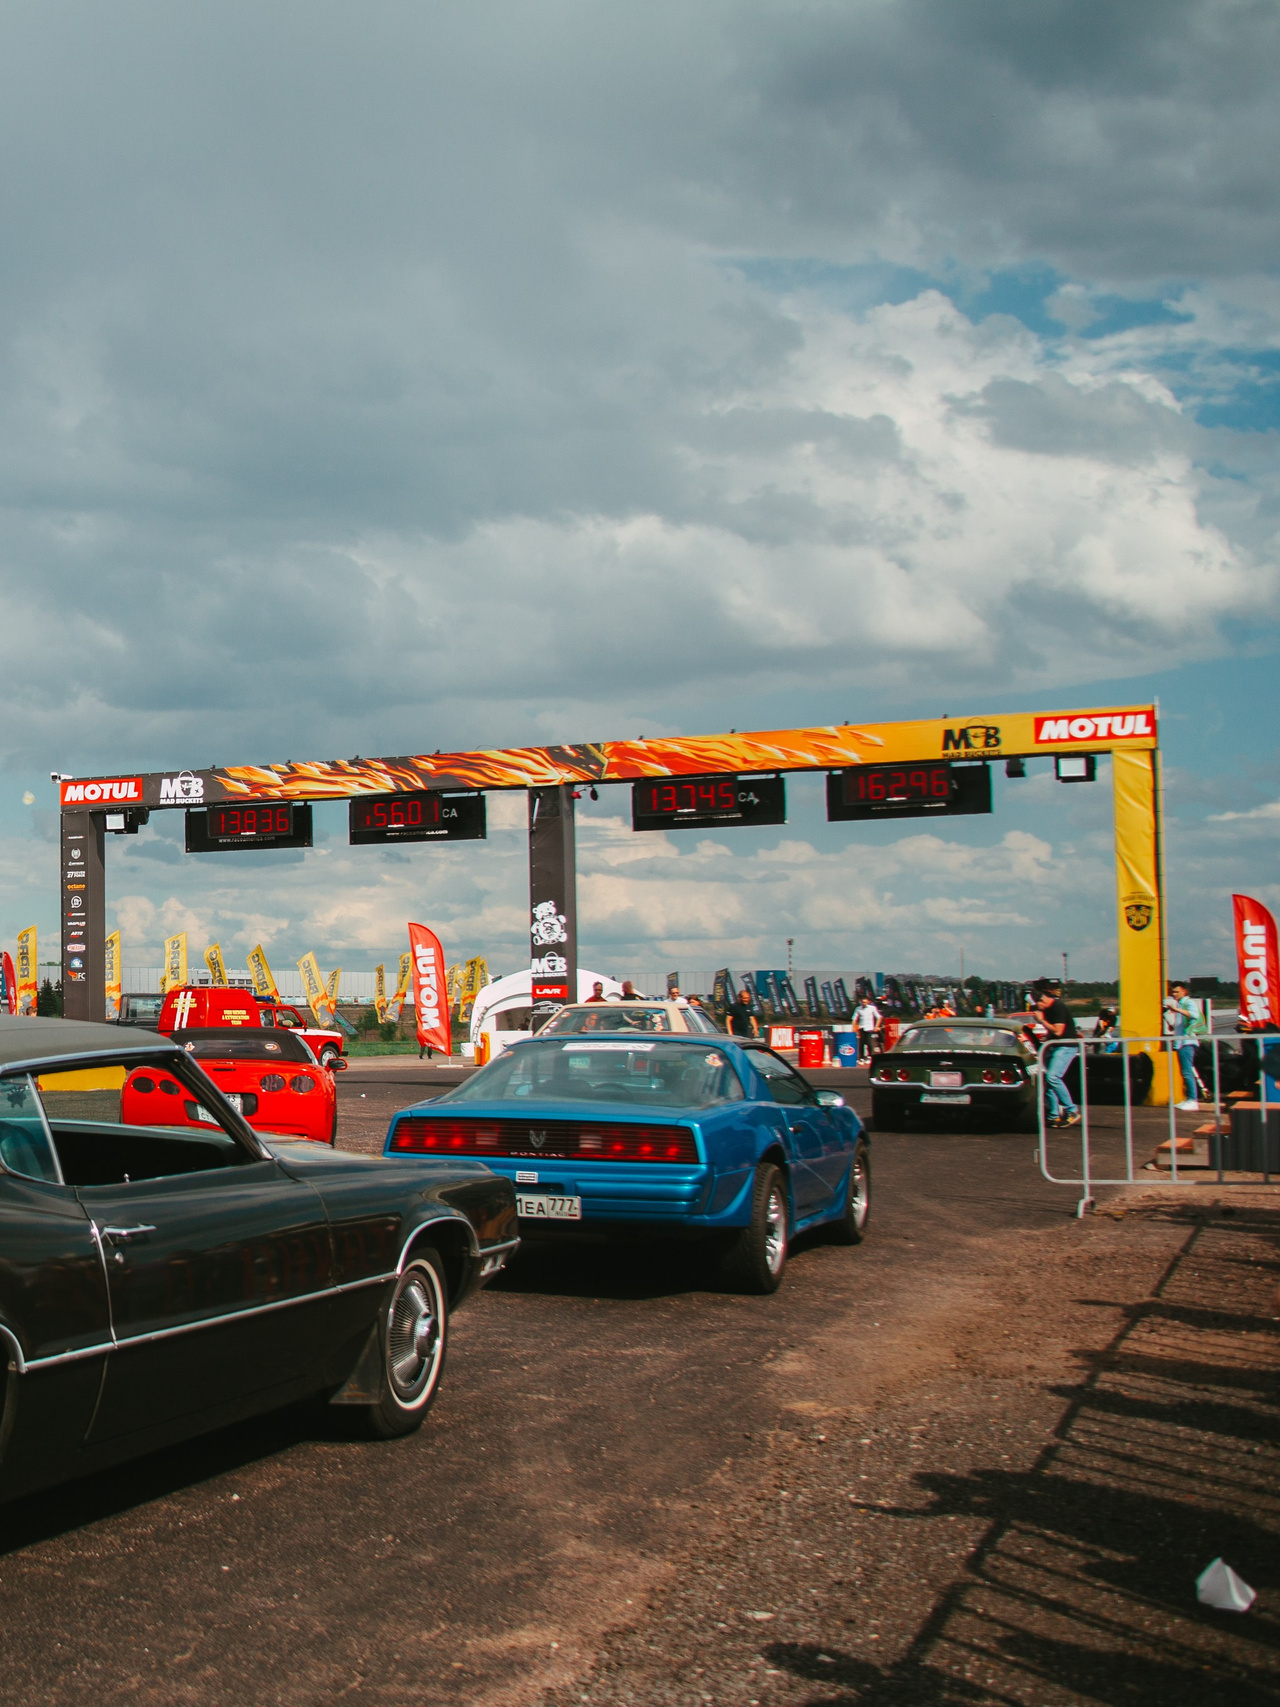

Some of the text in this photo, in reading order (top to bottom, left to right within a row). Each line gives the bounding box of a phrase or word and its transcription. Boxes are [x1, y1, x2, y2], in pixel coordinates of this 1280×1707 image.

[1038, 714, 1151, 740] MOTUL
[64, 782, 139, 802] MOTUL
[548, 1198, 574, 1212] 777
